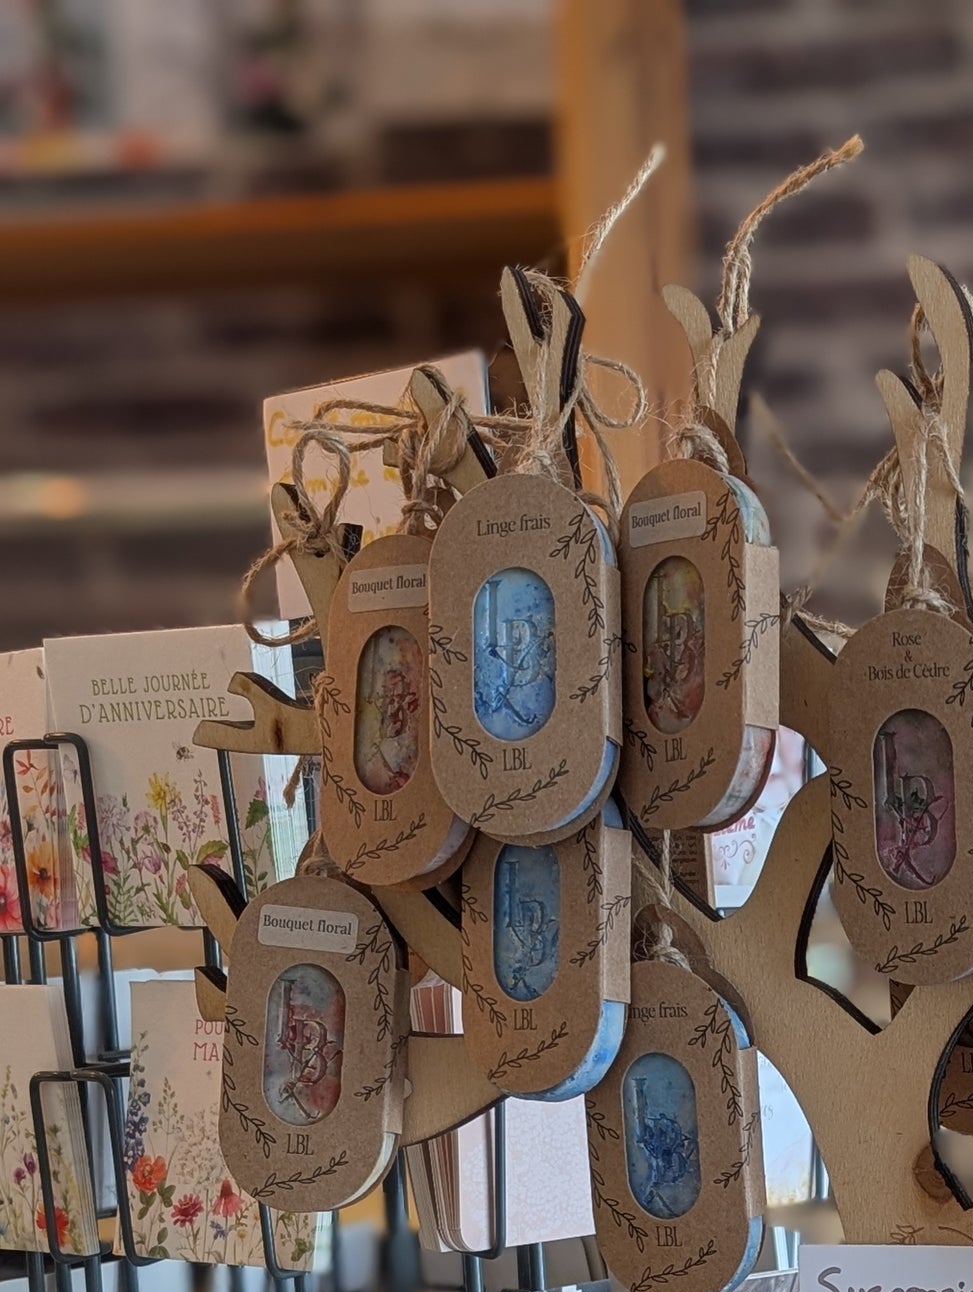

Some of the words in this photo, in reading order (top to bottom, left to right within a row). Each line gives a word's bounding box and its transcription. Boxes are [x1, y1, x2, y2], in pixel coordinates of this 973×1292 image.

[476, 518, 517, 537] Linge
[519, 514, 551, 532] frais
[631, 510, 674, 531] Bouquet
[676, 504, 702, 522] floral
[352, 579, 394, 596] Bouquet
[396, 575, 427, 590] floral
[892, 631, 922, 648] Rose
[904, 649, 914, 663] &
[91, 675, 138, 697] BELLE
[143, 669, 211, 694] JOURNÉE
[868, 665, 894, 682] Bois
[896, 663, 911, 680] de
[913, 661, 950, 679] Cèdre
[79, 697, 230, 725] D'ANNIVERSAIRE
[502, 749, 532, 772] LBL
[664, 737, 687, 763] LBL
[373, 799, 398, 822] LBL
[904, 901, 933, 925] LBL
[262, 913, 314, 936] Bouquet
[316, 918, 352, 937] floral
[513, 1009, 538, 1031] LBL
[659, 1001, 688, 1018] frais
[286, 1134, 314, 1156] LBL
[656, 1226, 684, 1248] LBL
